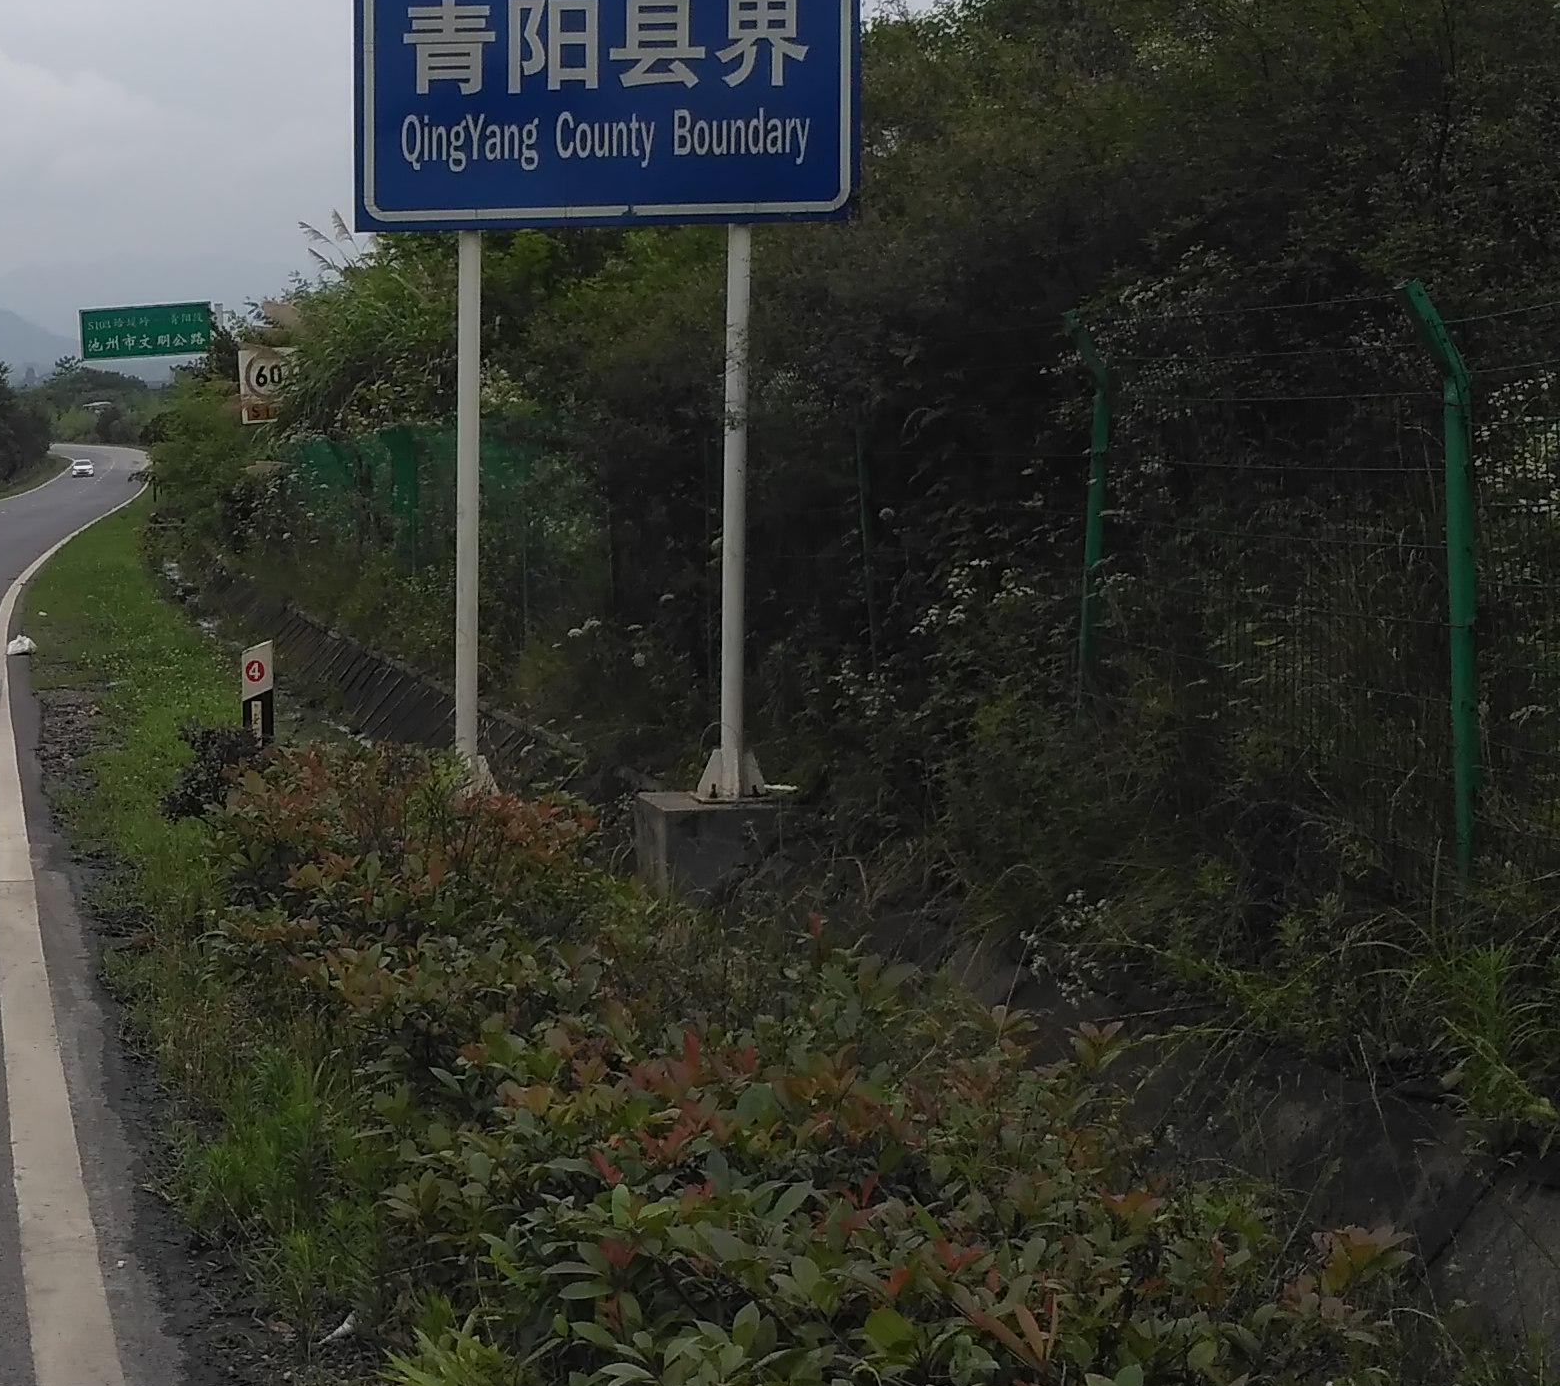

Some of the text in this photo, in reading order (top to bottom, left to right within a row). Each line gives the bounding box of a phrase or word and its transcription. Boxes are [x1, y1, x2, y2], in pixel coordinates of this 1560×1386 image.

[401, 107, 811, 172] QingYang County Boundary
[87, 331, 206, 352] 池州市文明公路
[255, 364, 282, 388] 60
[248, 662, 261, 681] 4
